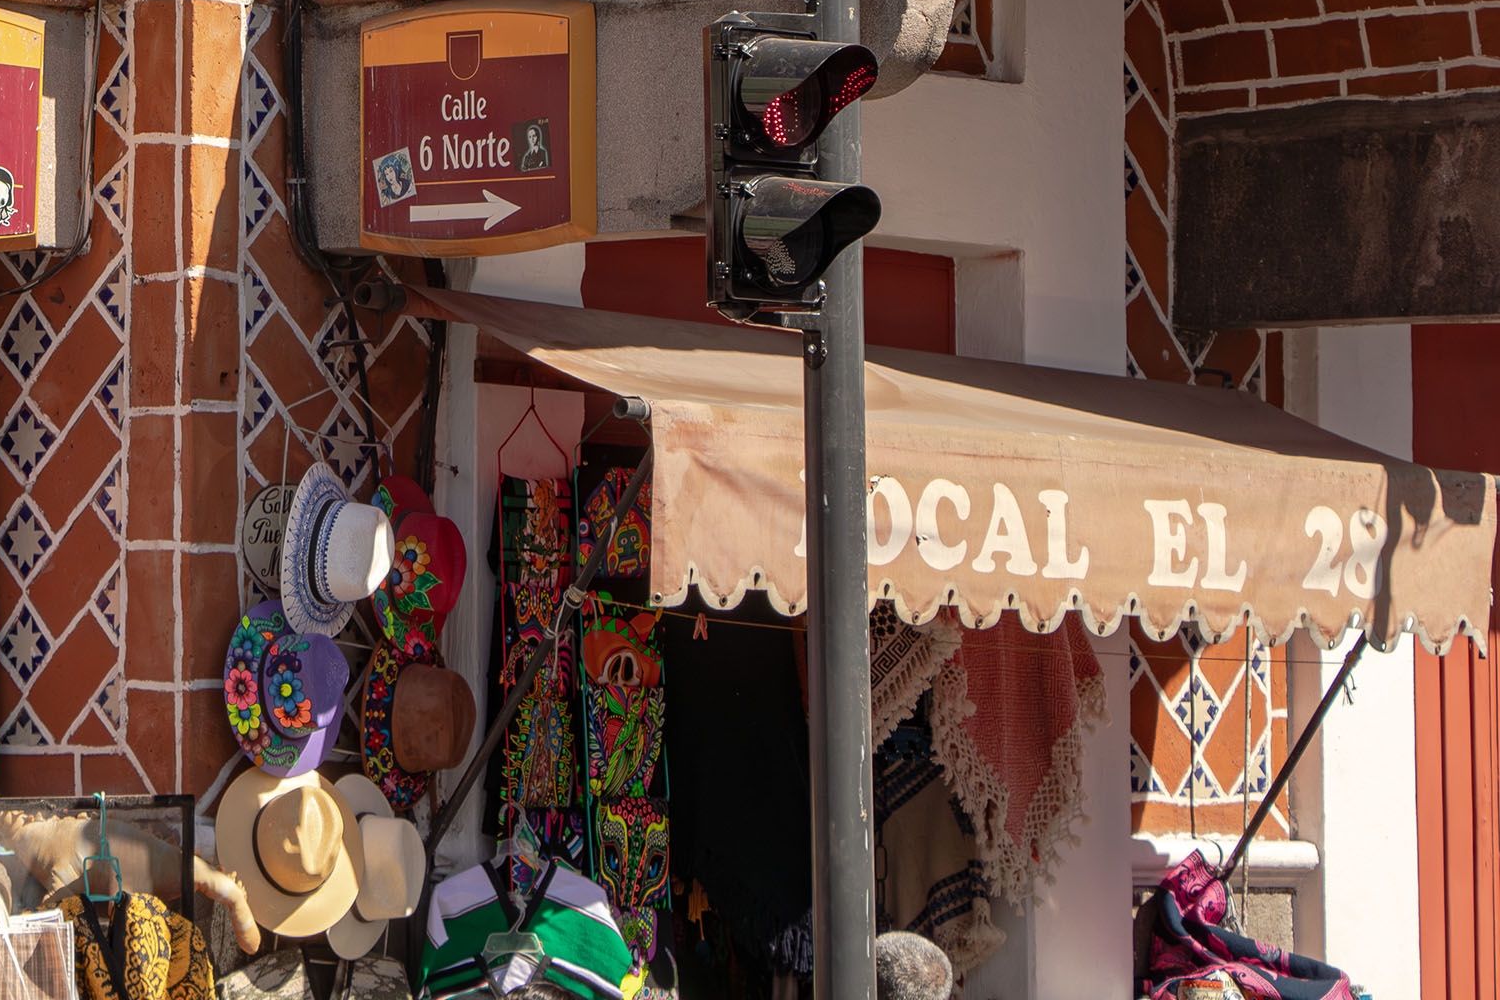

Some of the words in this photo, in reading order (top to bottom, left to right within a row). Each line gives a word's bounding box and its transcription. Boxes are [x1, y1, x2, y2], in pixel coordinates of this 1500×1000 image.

[441, 90, 487, 121] Calle
[419, 135, 433, 171] 6
[442, 131, 511, 170] Norte
[794, 469, 1090, 580] OCAL
[1144, 499, 1247, 593] EL
[1302, 505, 1388, 600] 28
